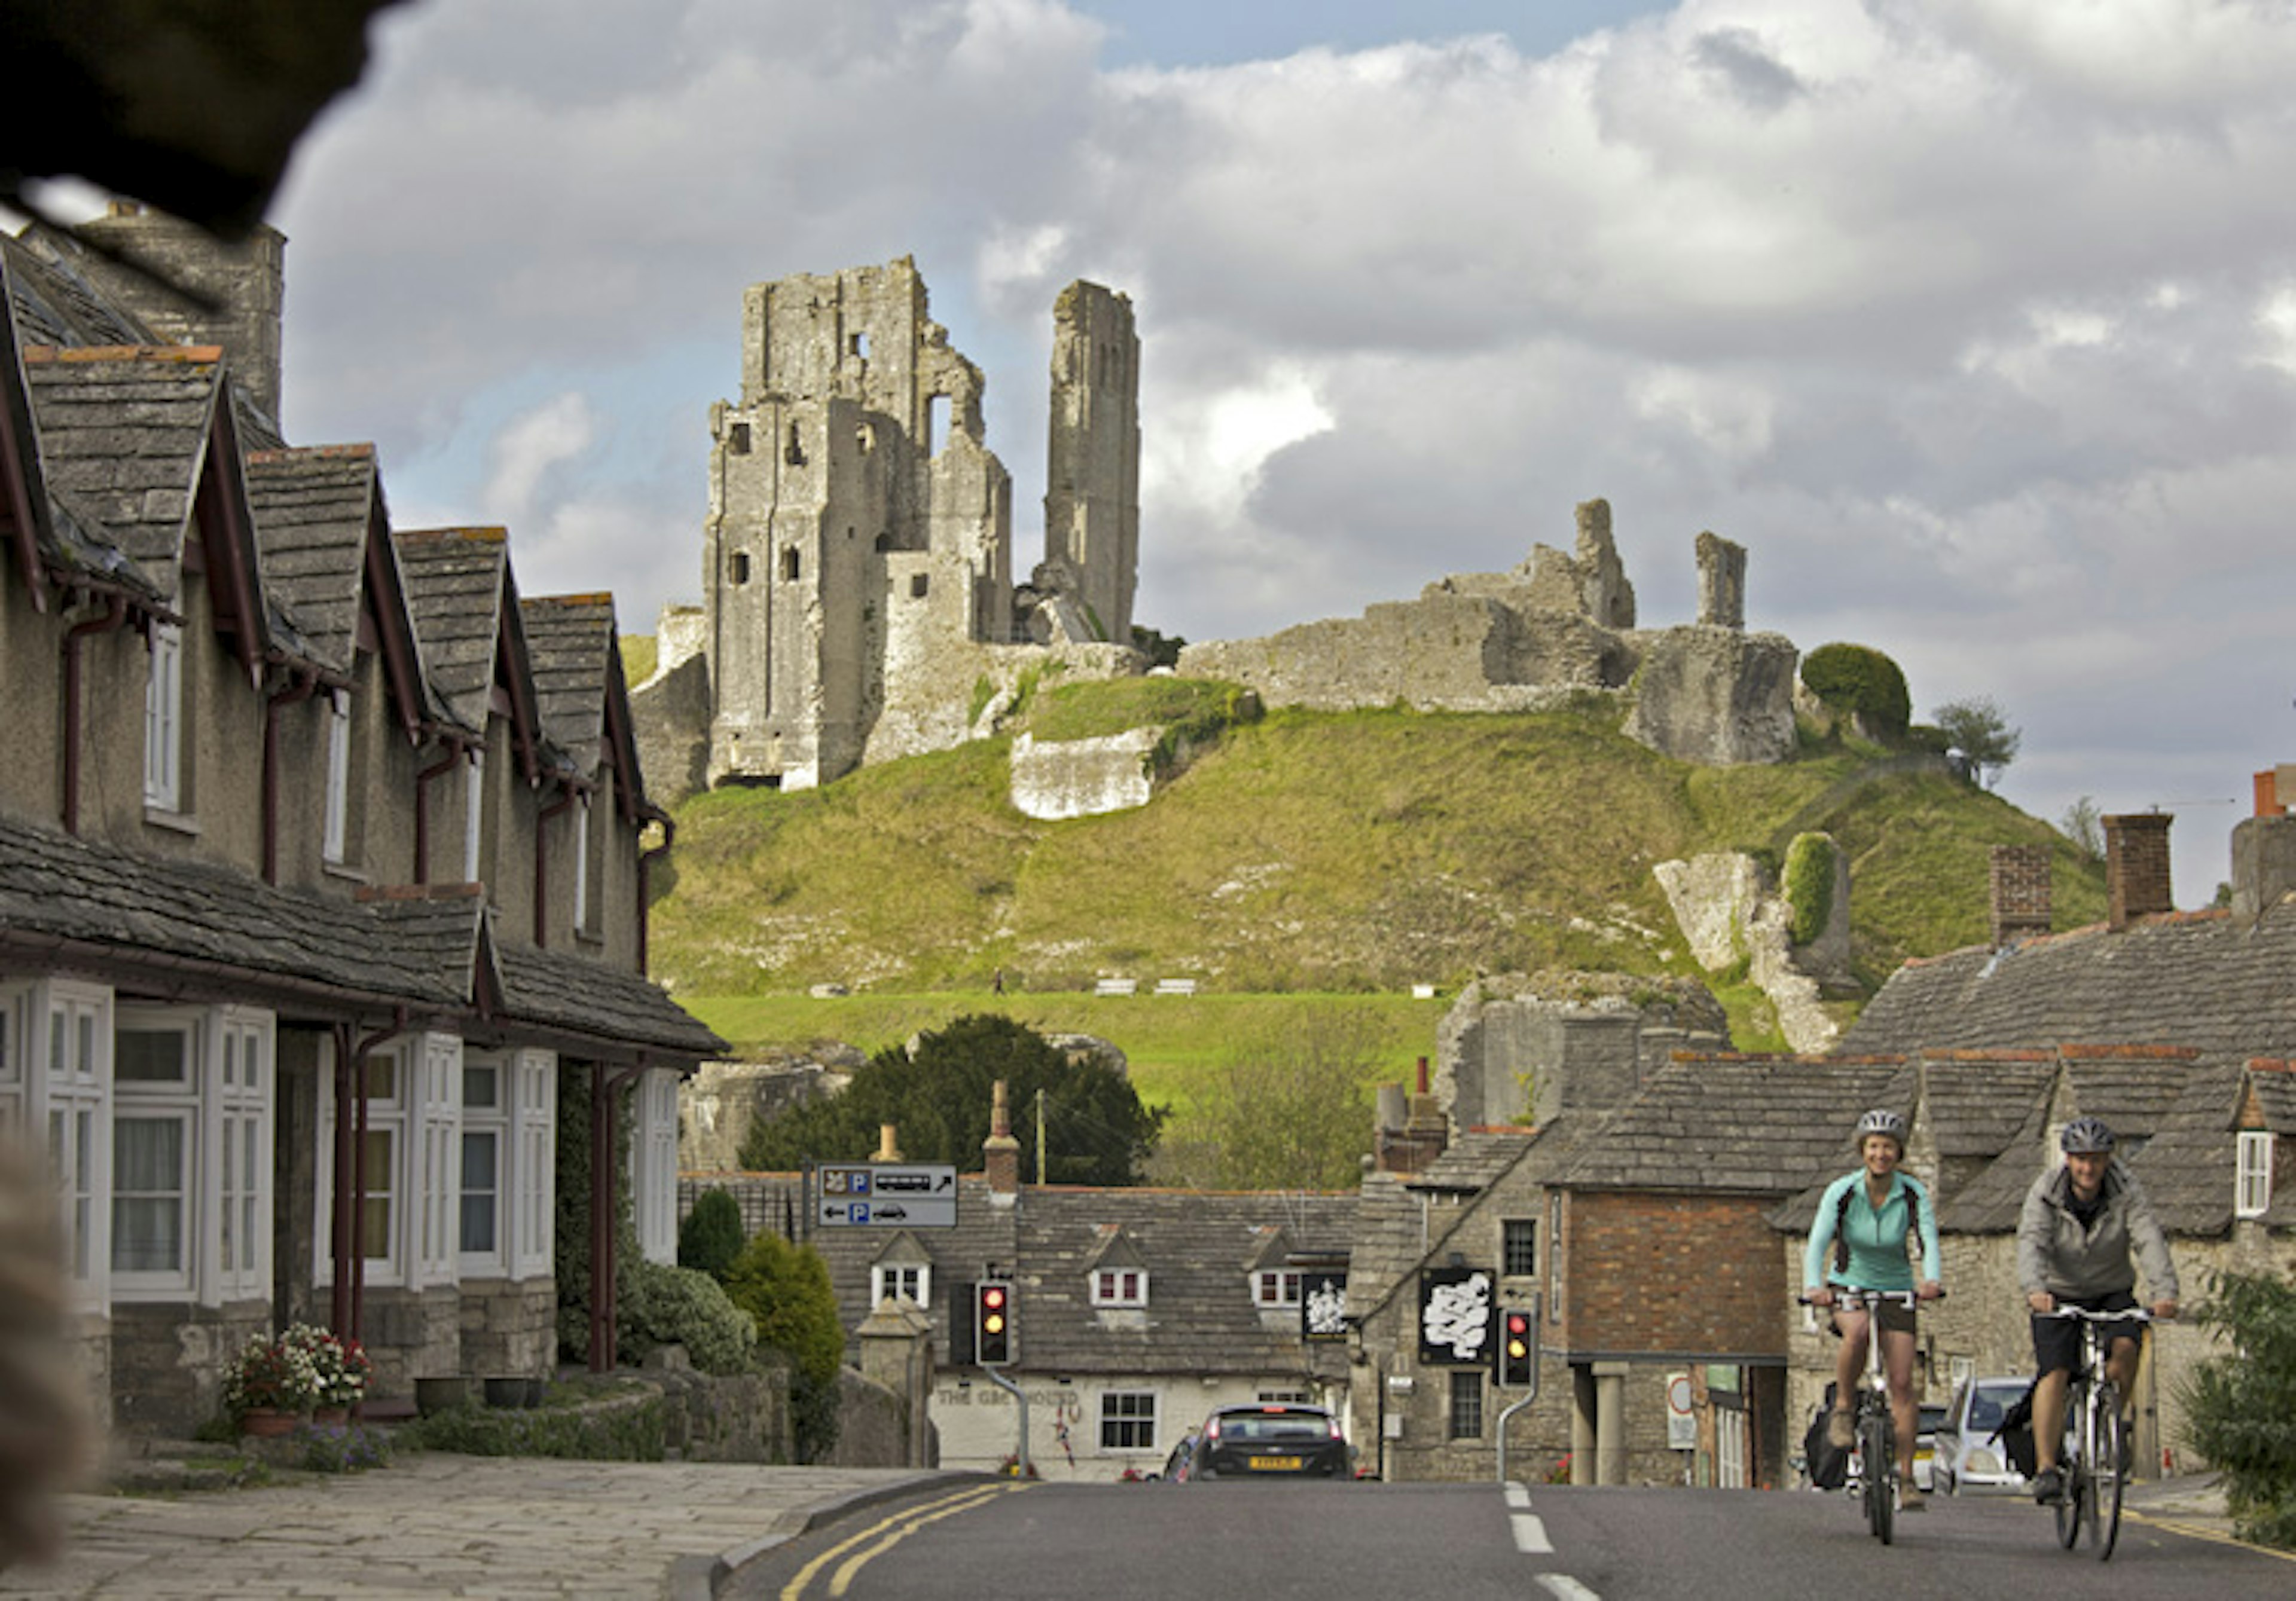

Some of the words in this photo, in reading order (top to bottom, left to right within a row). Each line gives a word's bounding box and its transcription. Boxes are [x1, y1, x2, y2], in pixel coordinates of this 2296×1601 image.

[853, 1174, 866, 1192] P
[853, 1205, 866, 1222] P
[938, 1389, 970, 1406] THE
